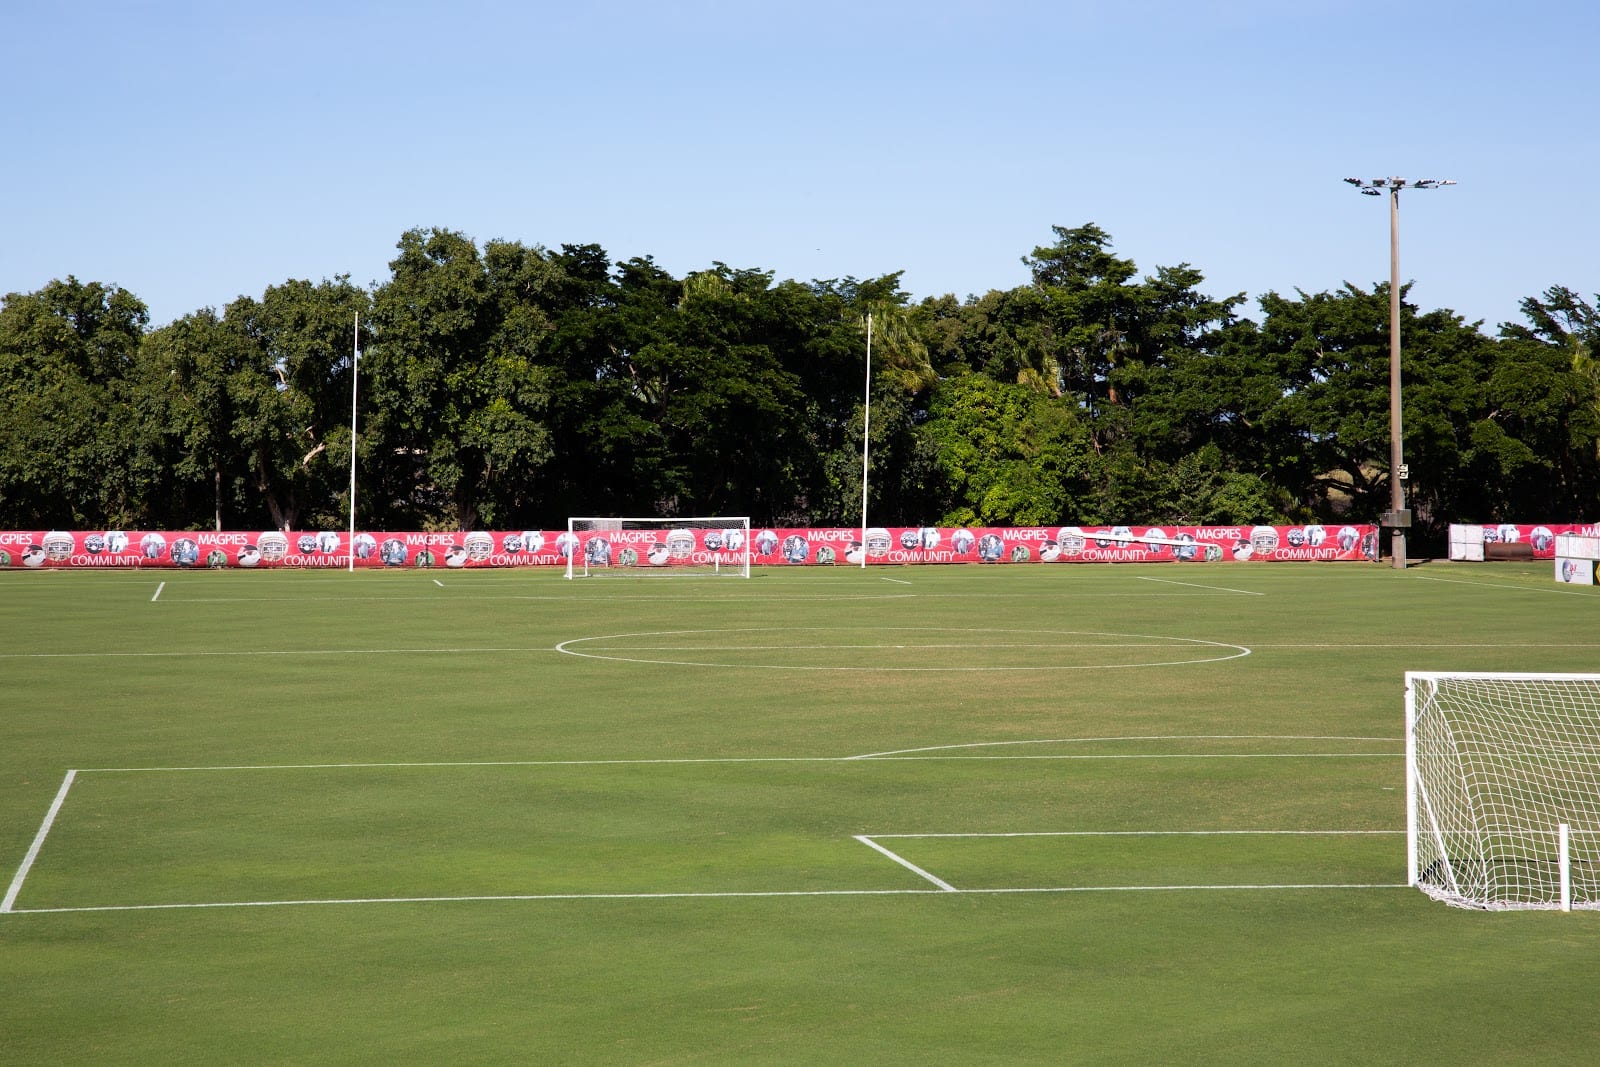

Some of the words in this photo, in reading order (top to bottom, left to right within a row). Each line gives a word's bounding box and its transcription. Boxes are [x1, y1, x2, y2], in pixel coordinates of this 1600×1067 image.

[0, 534, 33, 545] GPIES
[198, 534, 248, 545] MAGPIES
[406, 534, 455, 545] MAGPIES
[610, 532, 657, 543] MAGPIES
[807, 530, 854, 541] MAGPIES
[1002, 529, 1048, 541] MAGPIES
[1196, 528, 1242, 540] MAGPIES
[691, 552, 759, 563] COMMUNIY
[888, 551, 955, 562] COMMUNITY
[1082, 549, 1149, 561] COMMUNITY
[1275, 548, 1340, 559] COMMUNITY
[70, 555, 145, 566] COMMUNITY
[490, 554, 560, 566] COMMUNITY
